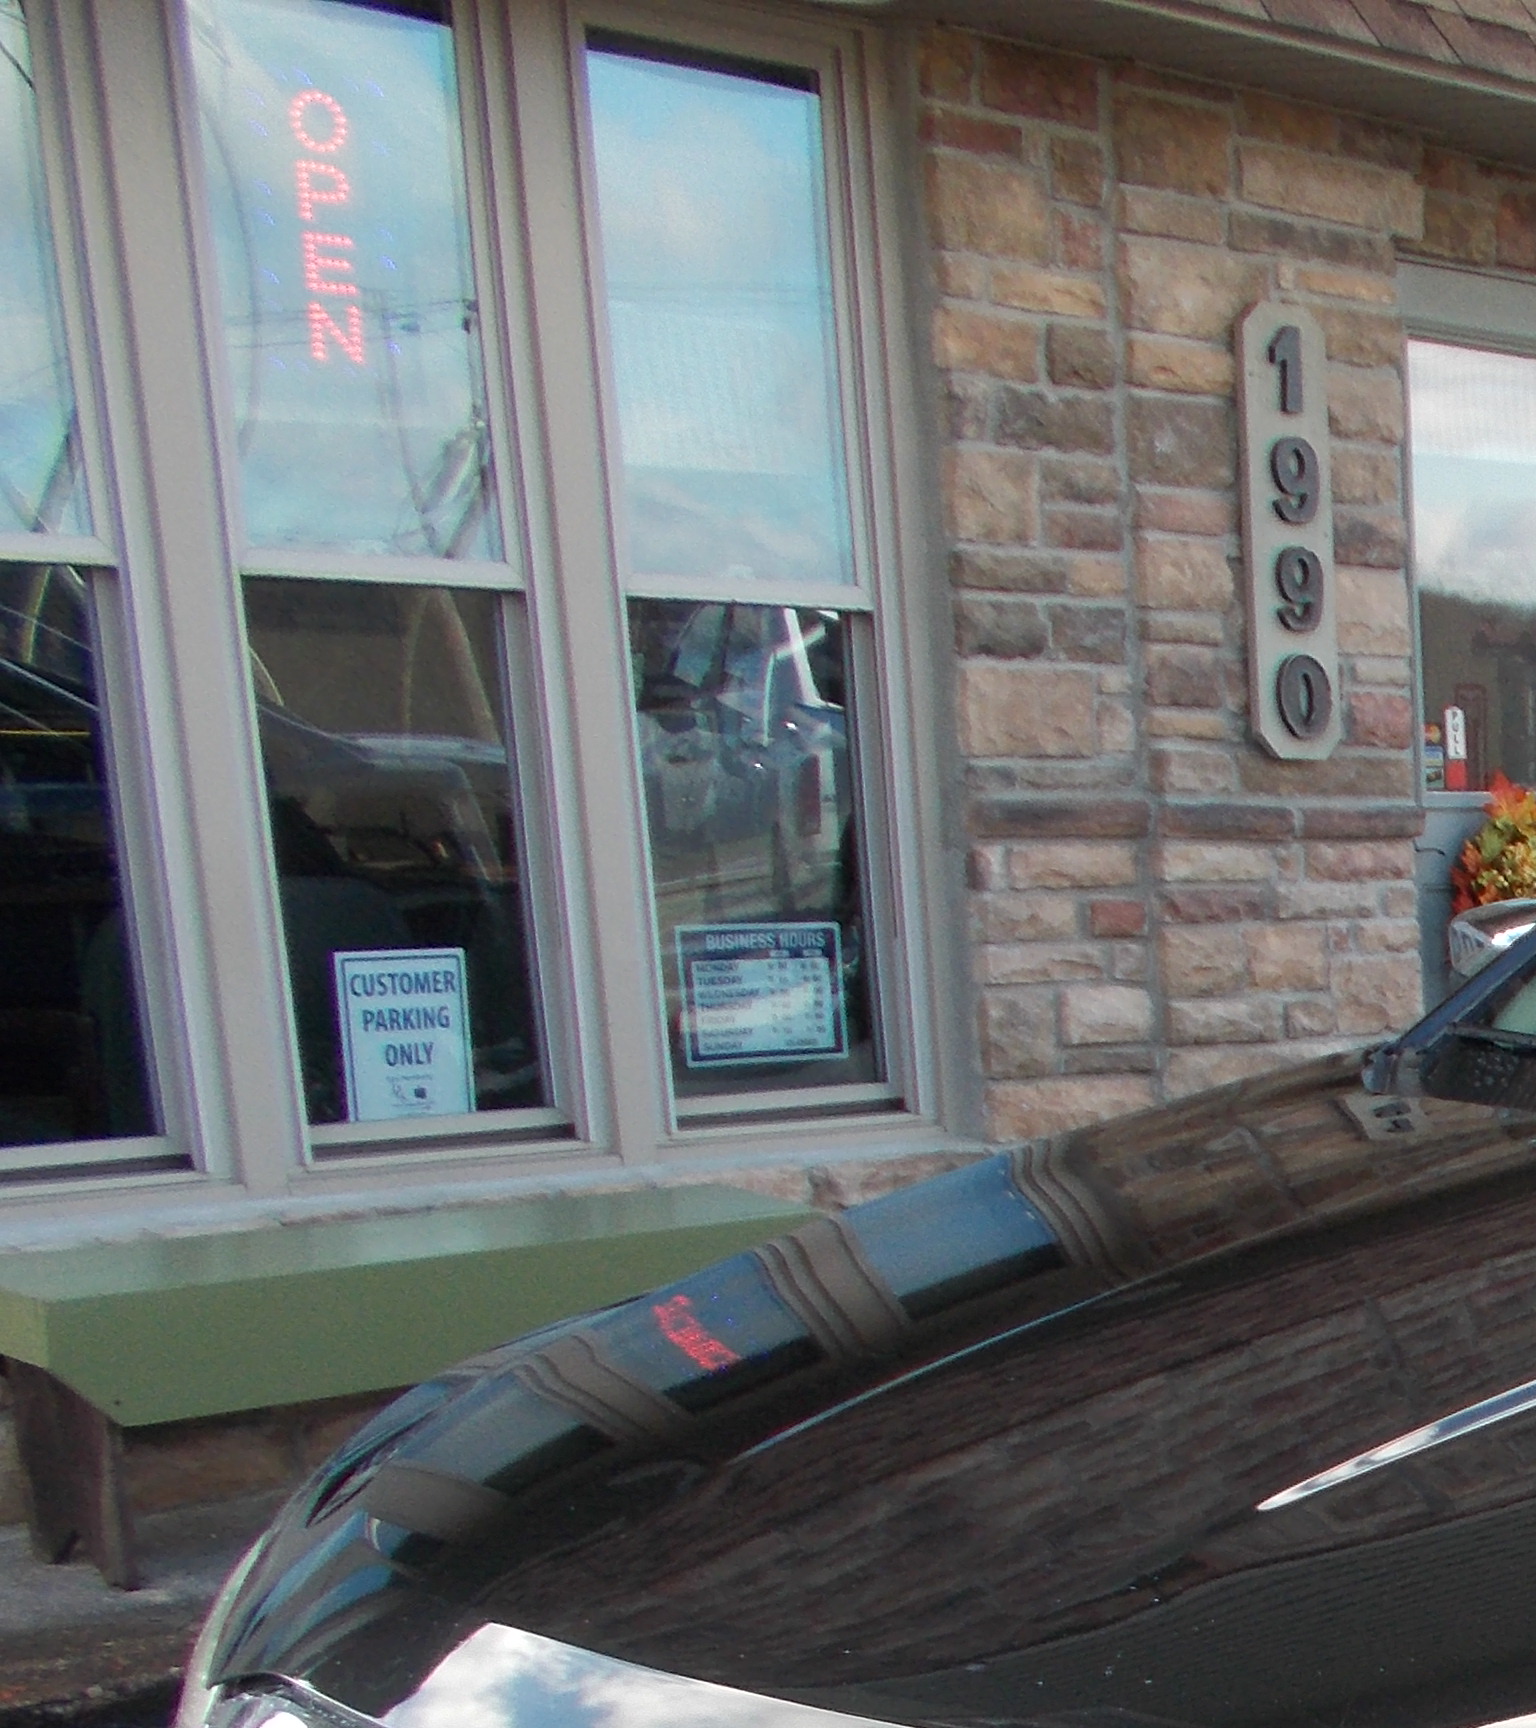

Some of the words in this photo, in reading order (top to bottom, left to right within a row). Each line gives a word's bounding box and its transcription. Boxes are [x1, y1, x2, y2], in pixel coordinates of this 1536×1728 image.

[289, 89, 366, 365] OPEN
[1268, 325, 1332, 740] 1990
[1451, 710, 1460, 756] PULL
[706, 932, 776, 950] BUSINESS
[779, 931, 826, 948] HOURS
[350, 970, 457, 997] CUSTOMER
[362, 1006, 450, 1032] PARKING
[385, 1042, 434, 1067] ONLY
